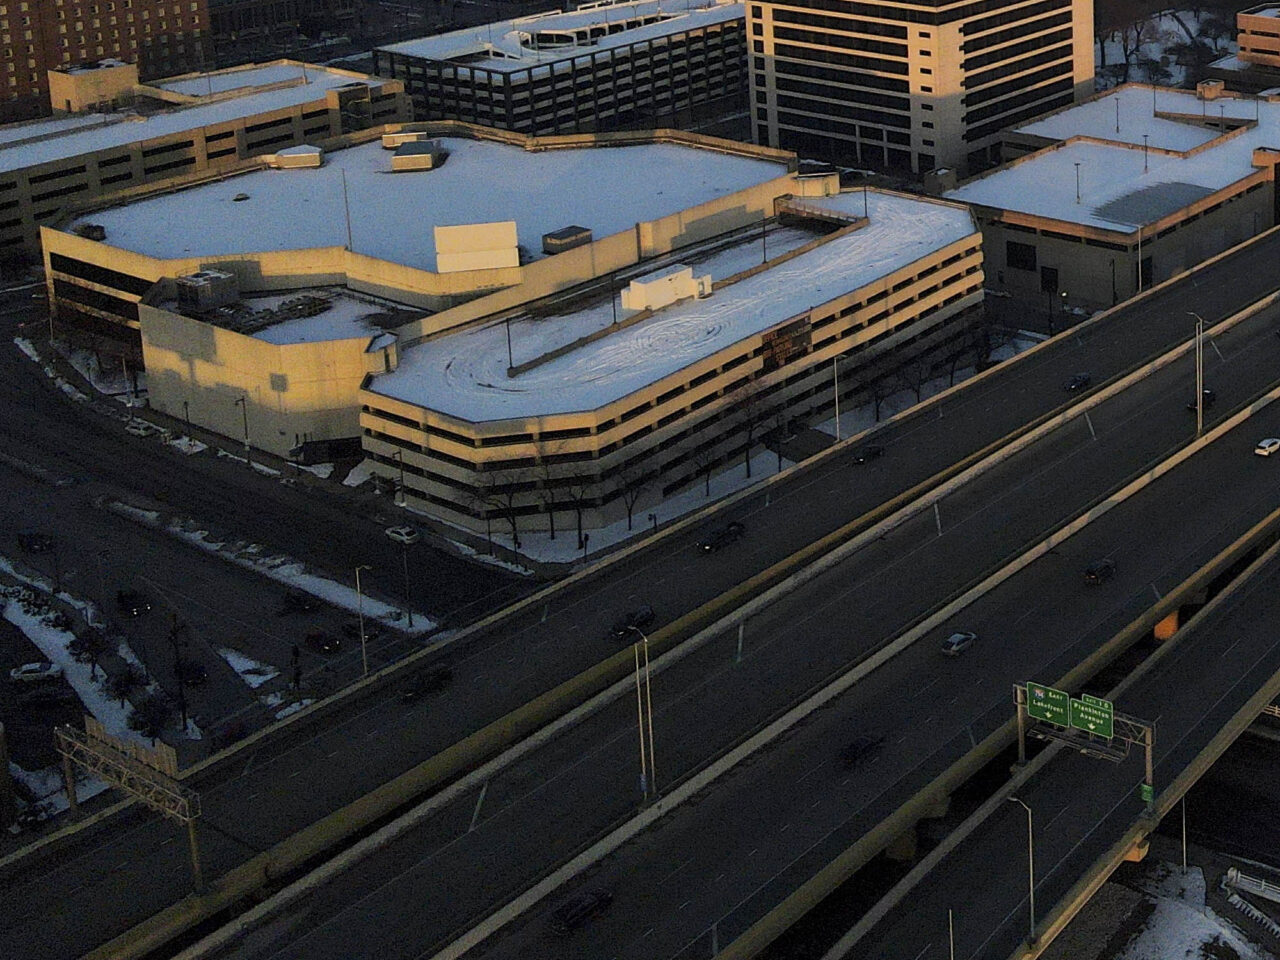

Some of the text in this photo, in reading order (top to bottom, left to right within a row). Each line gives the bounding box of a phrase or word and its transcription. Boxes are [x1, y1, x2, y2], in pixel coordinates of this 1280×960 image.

[1032, 699, 1064, 714] Lakefront
[1073, 702, 1110, 720] Plankinton
[1079, 712, 1104, 725] Avenue
